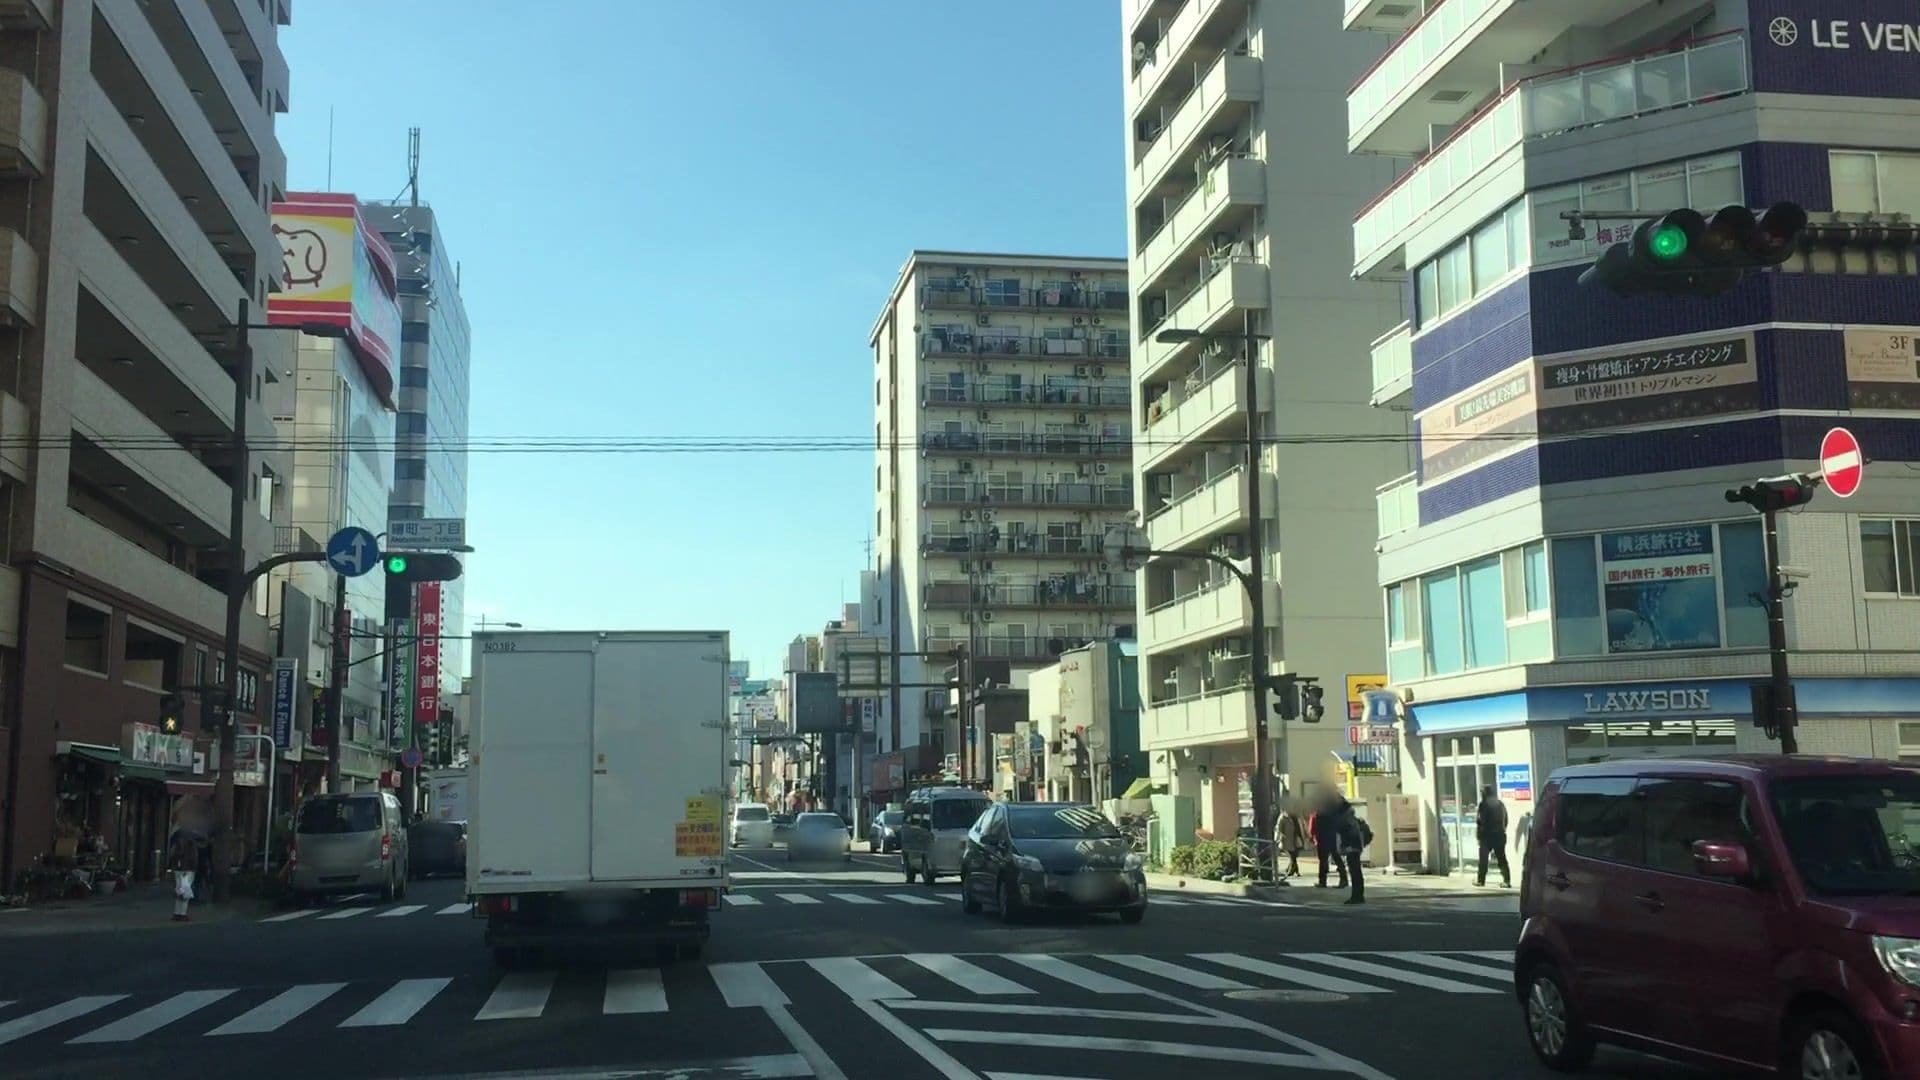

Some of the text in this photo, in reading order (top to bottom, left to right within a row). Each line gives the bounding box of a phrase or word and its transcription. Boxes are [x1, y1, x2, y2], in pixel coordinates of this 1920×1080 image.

[1811, 19, 1920, 53] LE VEN
[1890, 335, 1910, 350] 3F
[1616, 530, 1703, 553] 横浜旅行社
[1607, 562, 1712, 582] 国内旅行・海外旅行
[420, 612, 437, 710] 東日本銀行
[1583, 688, 1712, 713] LAWSON
